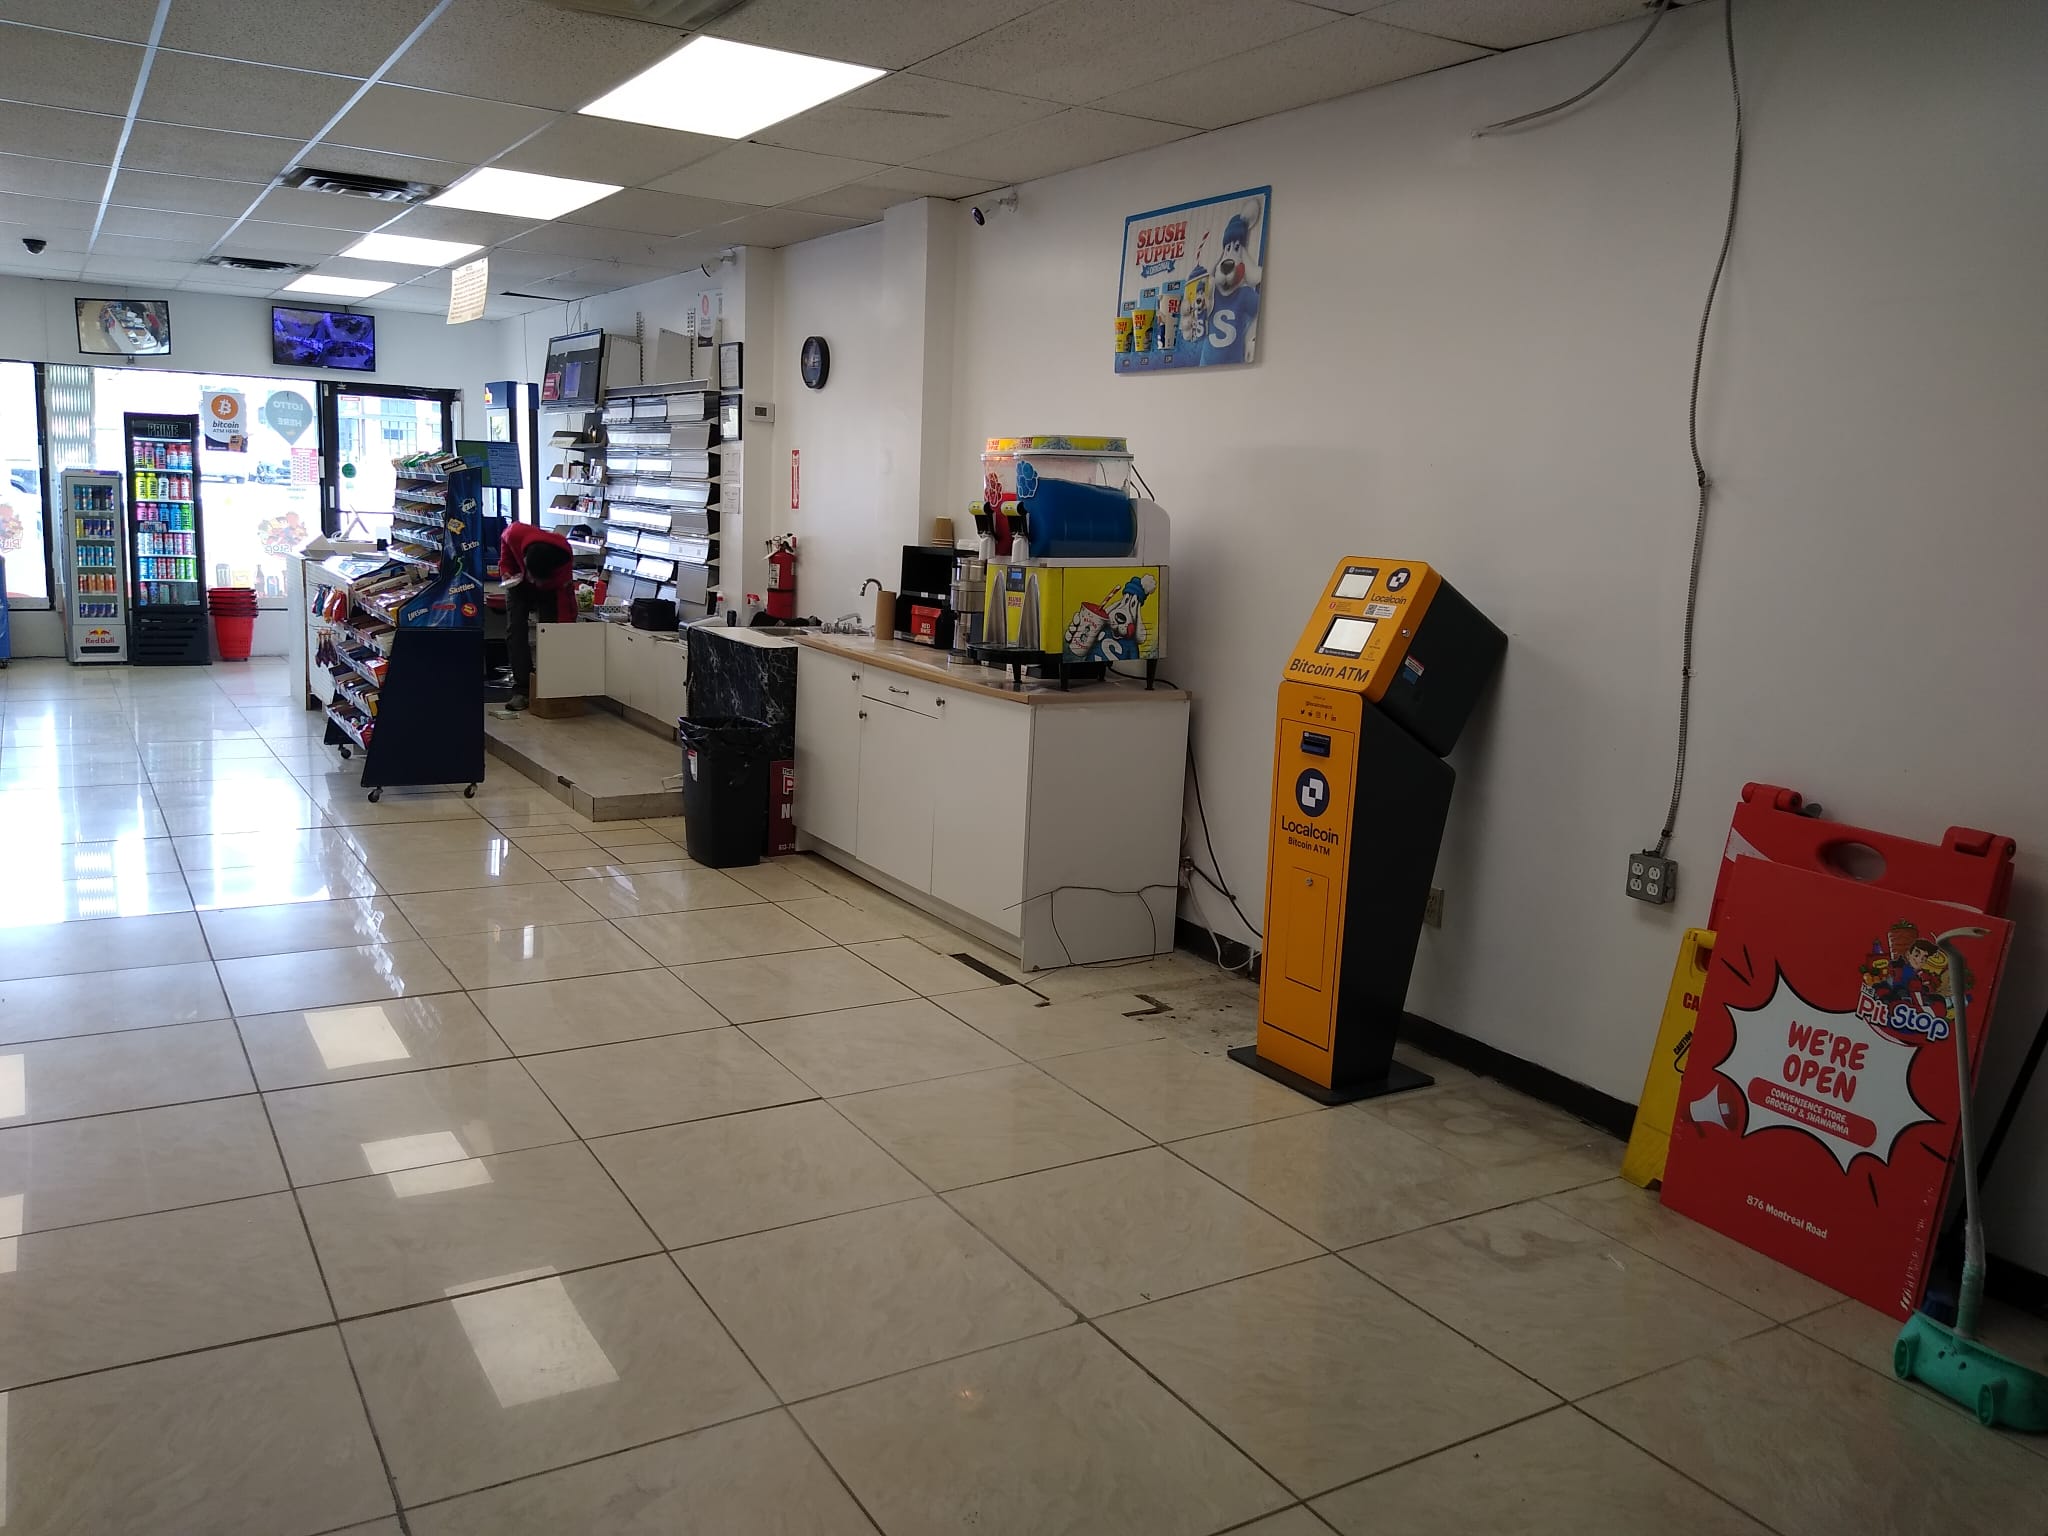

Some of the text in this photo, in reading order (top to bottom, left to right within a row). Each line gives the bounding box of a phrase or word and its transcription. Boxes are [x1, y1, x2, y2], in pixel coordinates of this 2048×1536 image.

[1137, 221, 1187, 248] SLUSH
[147, 423, 179, 437] PRIME
[212, 420, 240, 429] bitcoin
[462, 541, 480, 552] Extra
[1370, 592, 1407, 605] Localcoin
[1290, 658, 1370, 683] Bitcoin ATM
[1281, 815, 1339, 846] Localcoin
[1288, 836, 1331, 856] Bitcoin ATM
[1857, 993, 1950, 1041] Pit Stop
[1788, 1020, 1869, 1071] WE'RE
[1782, 1053, 1857, 1103] OPEN
[1770, 1088, 1824, 1113] CONVENIENCE
[1764, 1096, 1849, 1136] GROCERY & SHAWARMA
[1746, 1195, 1828, 1239] 876 Montreal Road
